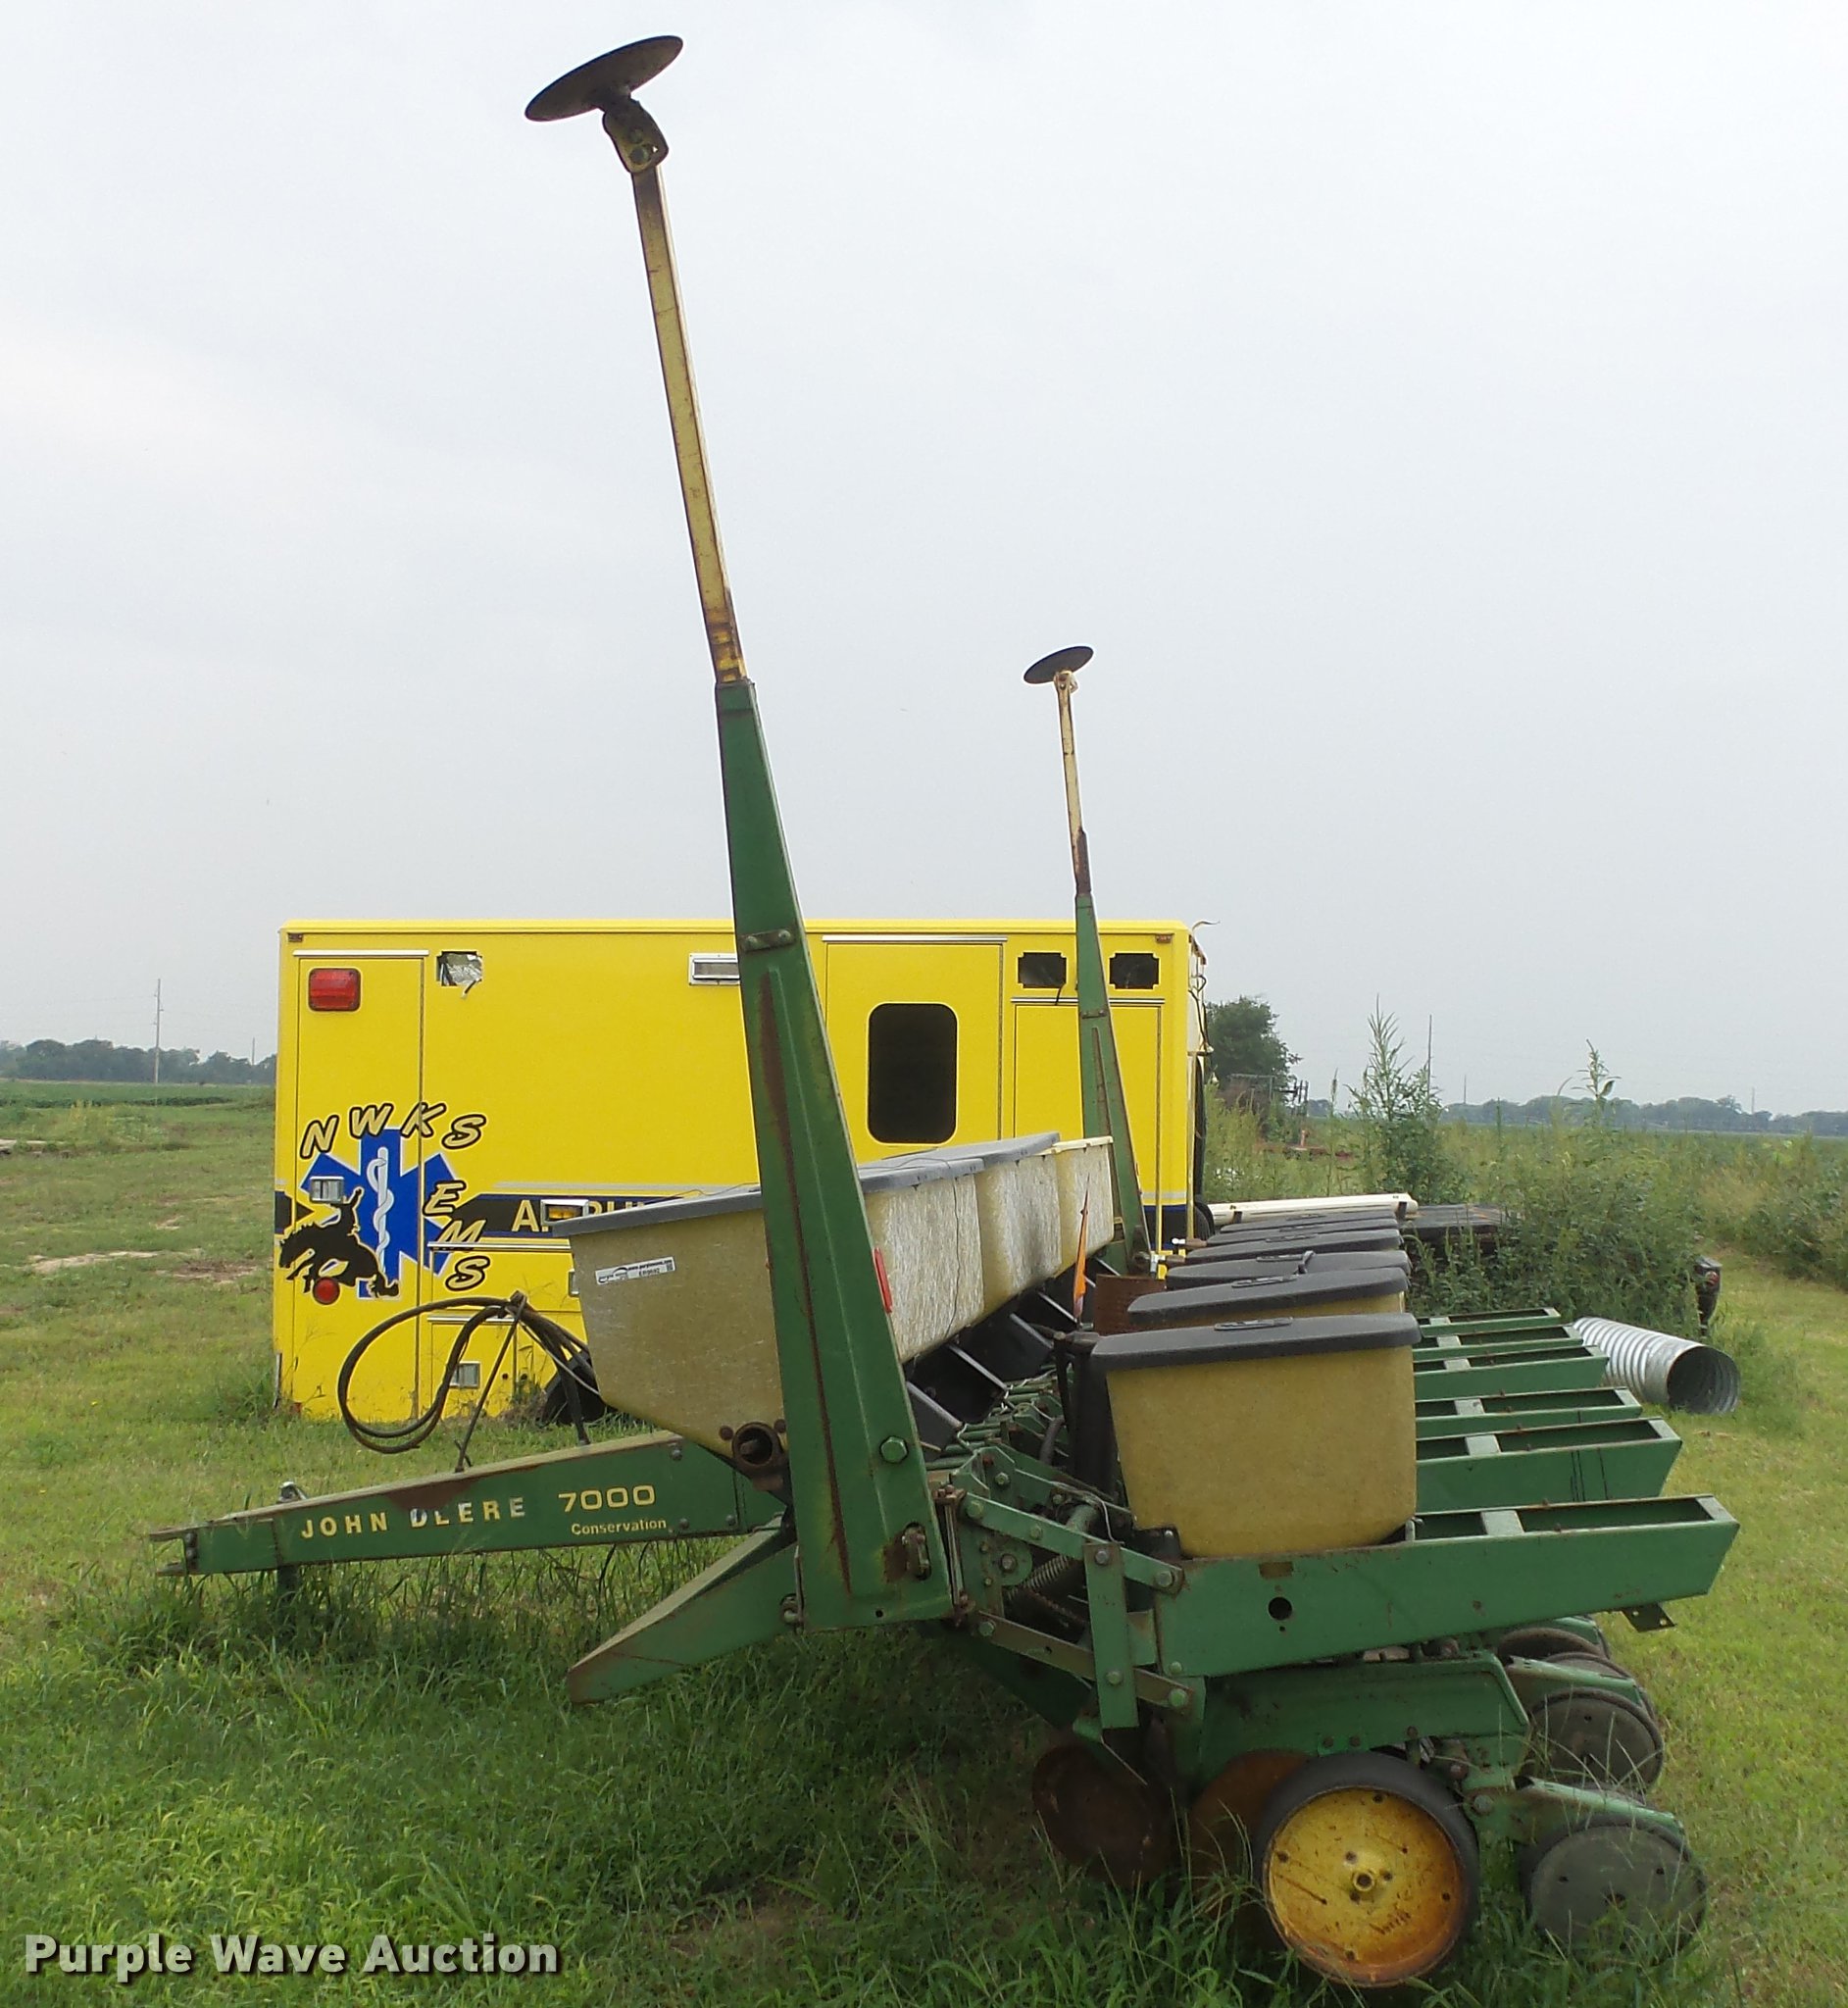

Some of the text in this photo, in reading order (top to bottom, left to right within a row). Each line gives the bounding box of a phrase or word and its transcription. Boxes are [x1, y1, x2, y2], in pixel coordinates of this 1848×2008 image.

[300, 1101, 487, 1159] NWKS
[422, 1180, 491, 1291] EMS
[300, 1511, 388, 1540] JOHN
[558, 1483, 657, 1513] 7000
[571, 1518, 668, 1536] Conservation
